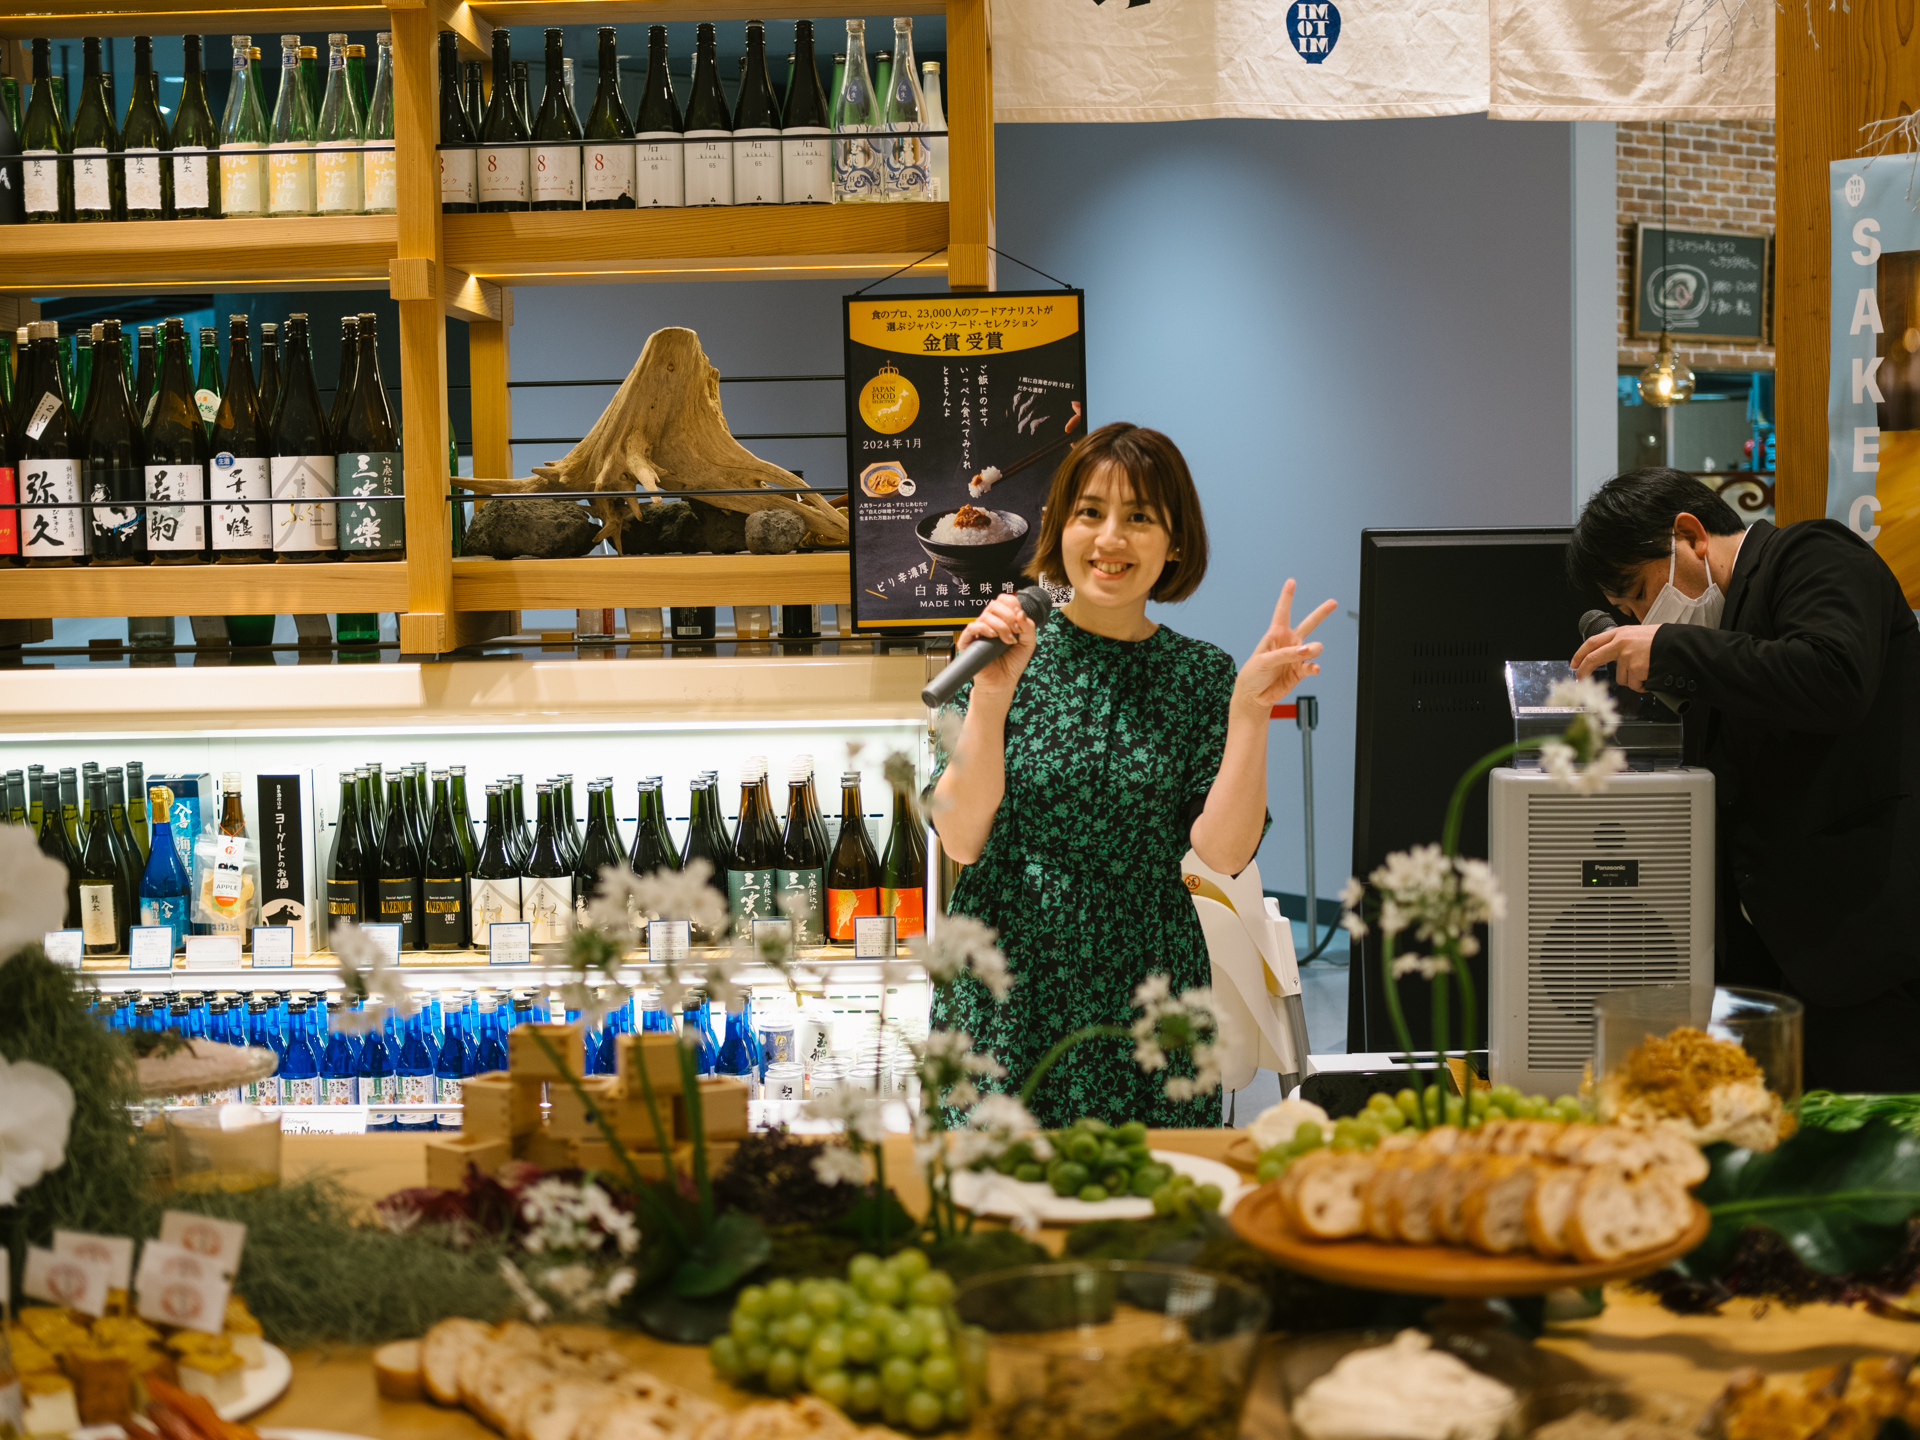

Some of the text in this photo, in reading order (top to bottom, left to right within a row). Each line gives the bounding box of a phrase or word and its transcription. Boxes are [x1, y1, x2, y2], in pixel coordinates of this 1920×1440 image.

[488, 155, 497, 172] 8
[537, 155, 546, 172] 8
[595, 153, 604, 171] 8
[886, 319, 1039, 332] 選ぶジャパン・フード・セレクション
[943, 366, 951, 418] とまらんよ
[977, 364, 989, 427] ご飯にのせて
[959, 366, 971, 469] いっぺん食べてみられ
[382, 457, 394, 503] 山廃仕込
[177, 472, 186, 513] 辛口純酒
[920, 600, 950, 608] MADE
[275, 813, 289, 890] ヨーグルトのお酒
[215, 883, 239, 891] APPLE
[425, 900, 460, 913] KAZENOBON
[444, 913, 455, 921] 2012
